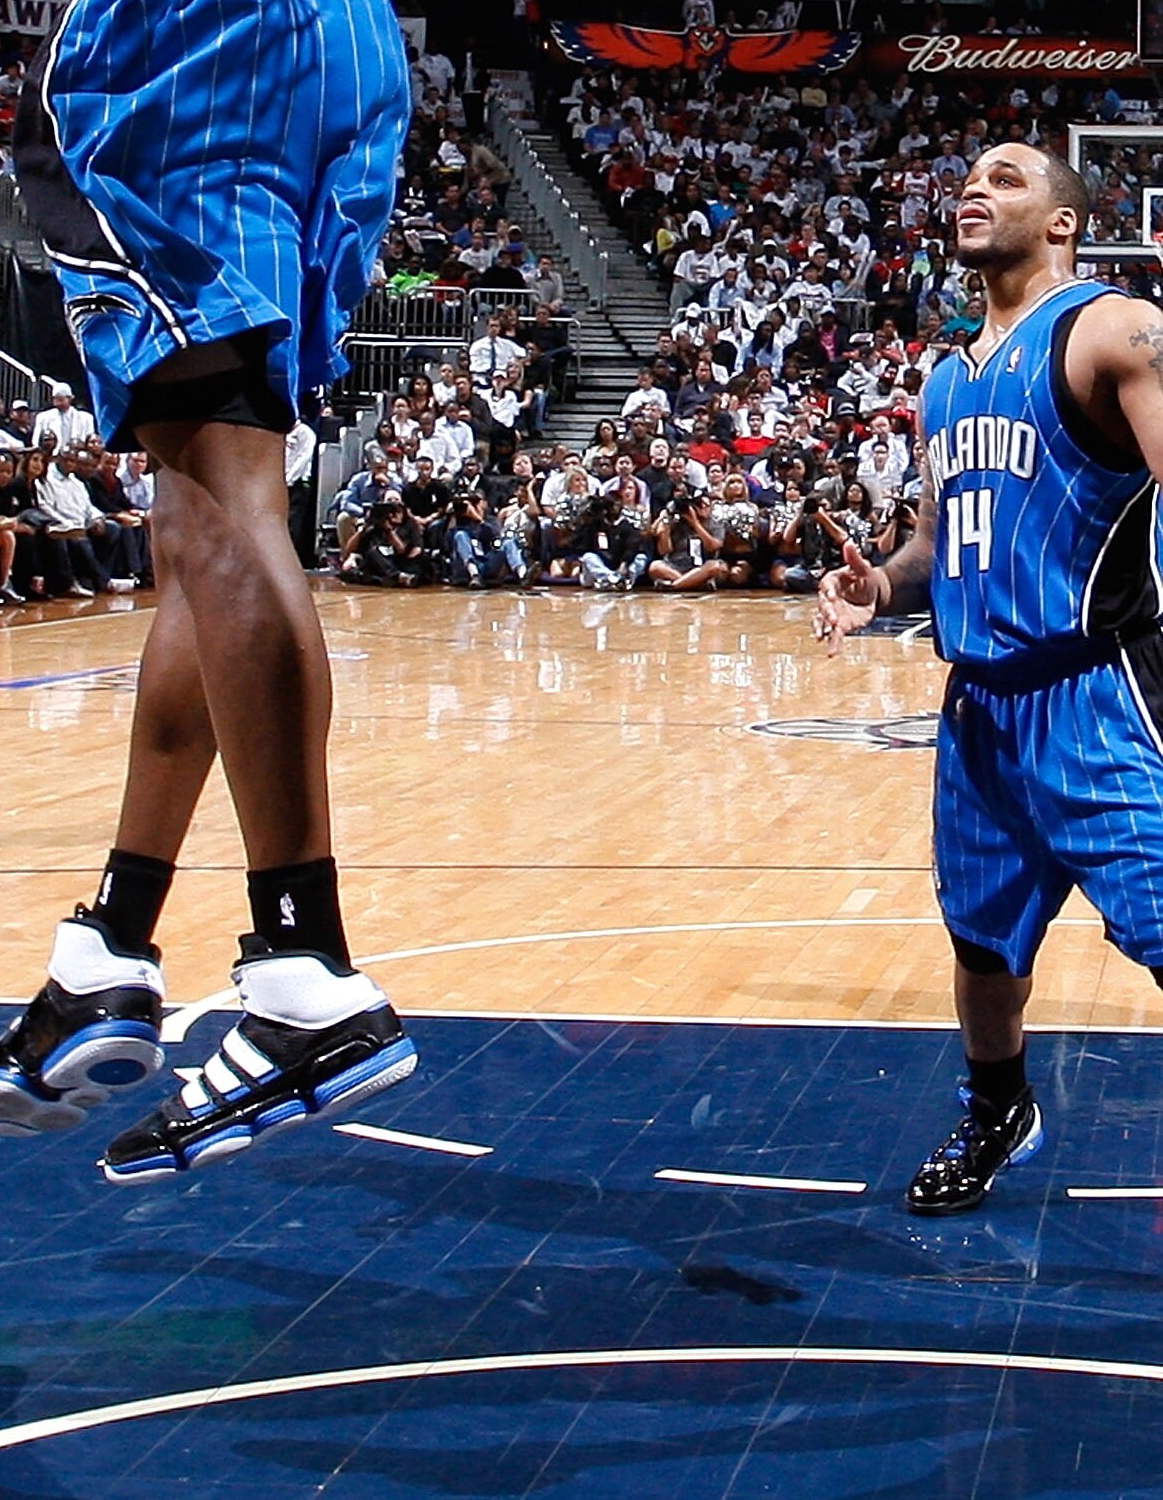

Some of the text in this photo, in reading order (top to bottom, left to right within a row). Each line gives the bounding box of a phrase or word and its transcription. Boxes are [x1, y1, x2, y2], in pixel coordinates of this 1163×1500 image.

[898, 33, 1138, 73] Budweiser
[927, 416, 1037, 498] RLANDO
[946, 488, 992, 579] 14
